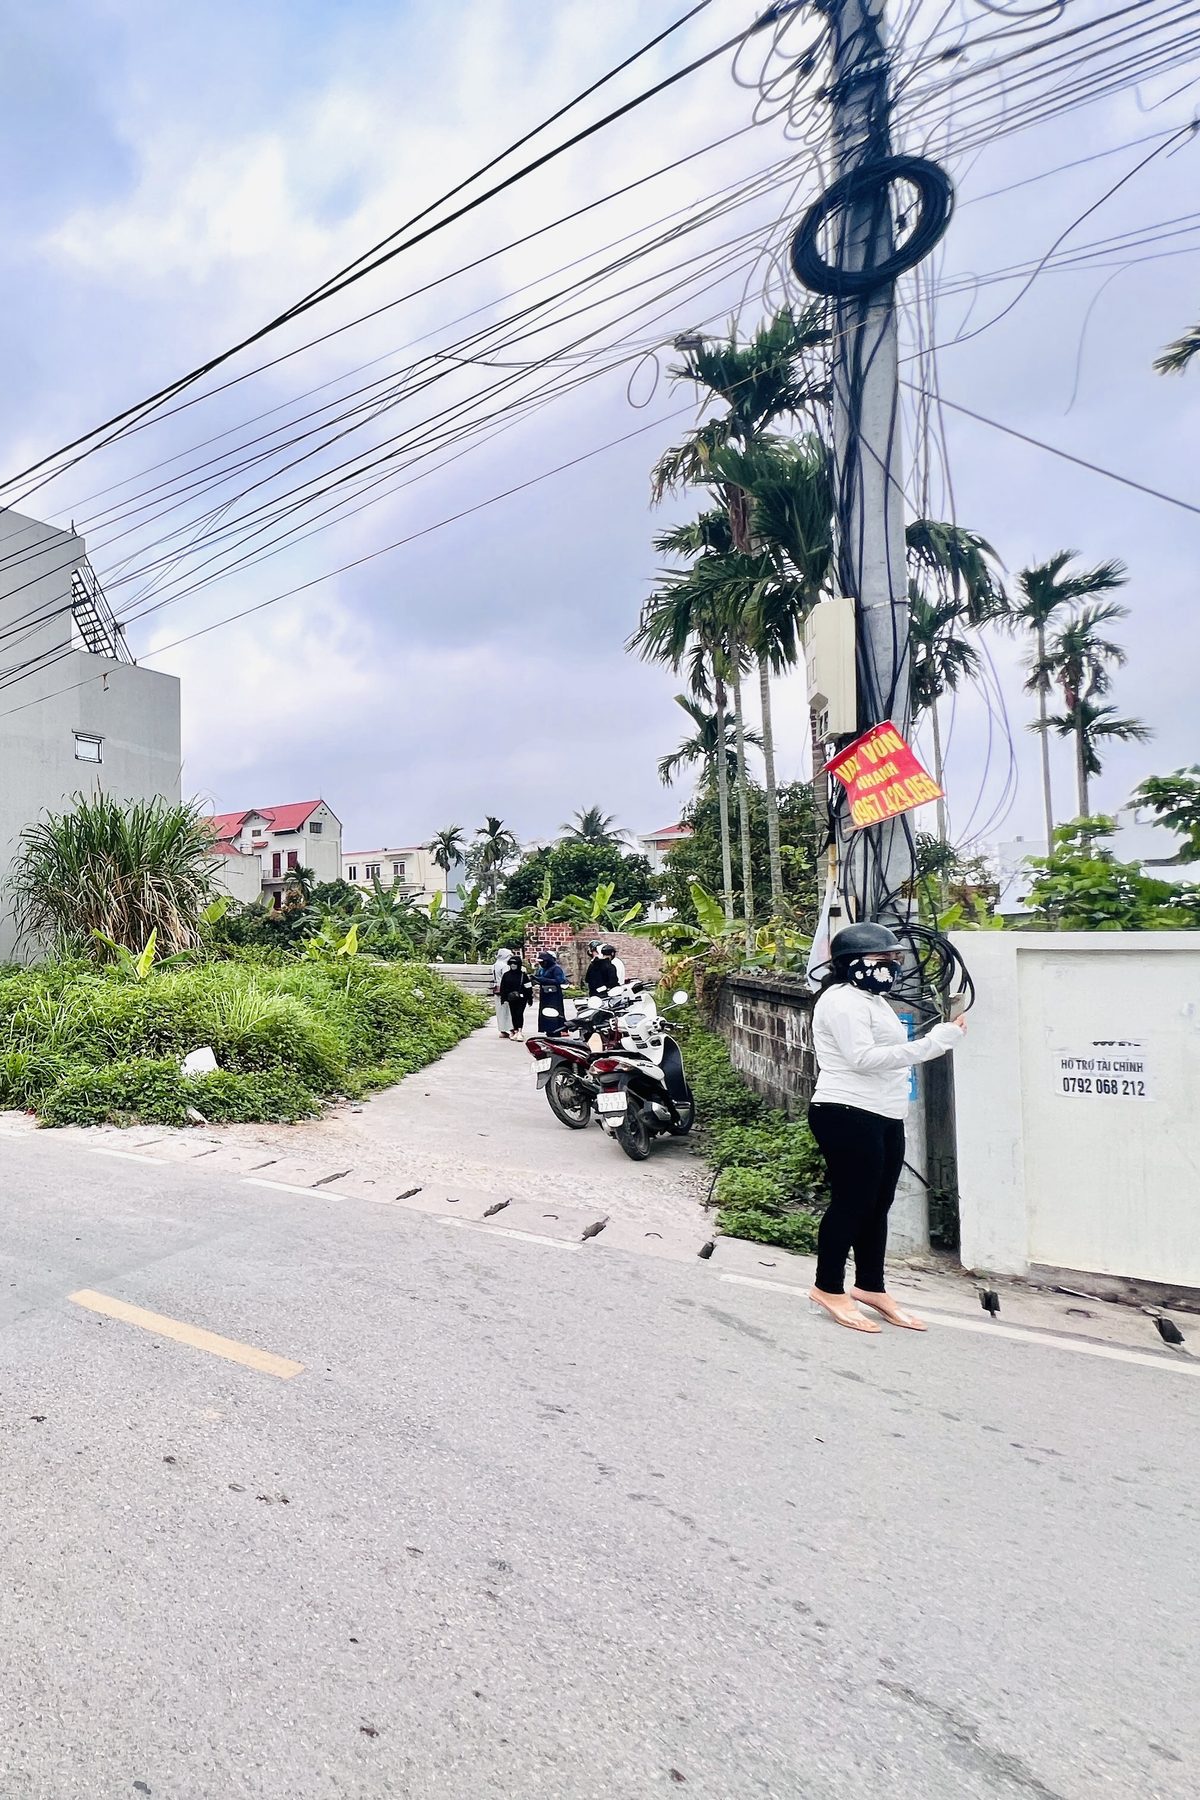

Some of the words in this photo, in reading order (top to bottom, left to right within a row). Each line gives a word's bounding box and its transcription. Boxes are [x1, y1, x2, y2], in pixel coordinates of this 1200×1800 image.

[861, 730, 904, 764] VỐN
[856, 761, 899, 790] NHANH
[1063, 1077, 1093, 1093] 0792
[1096, 1078, 1118, 1095] 068
[1122, 1080, 1146, 1097] 212
